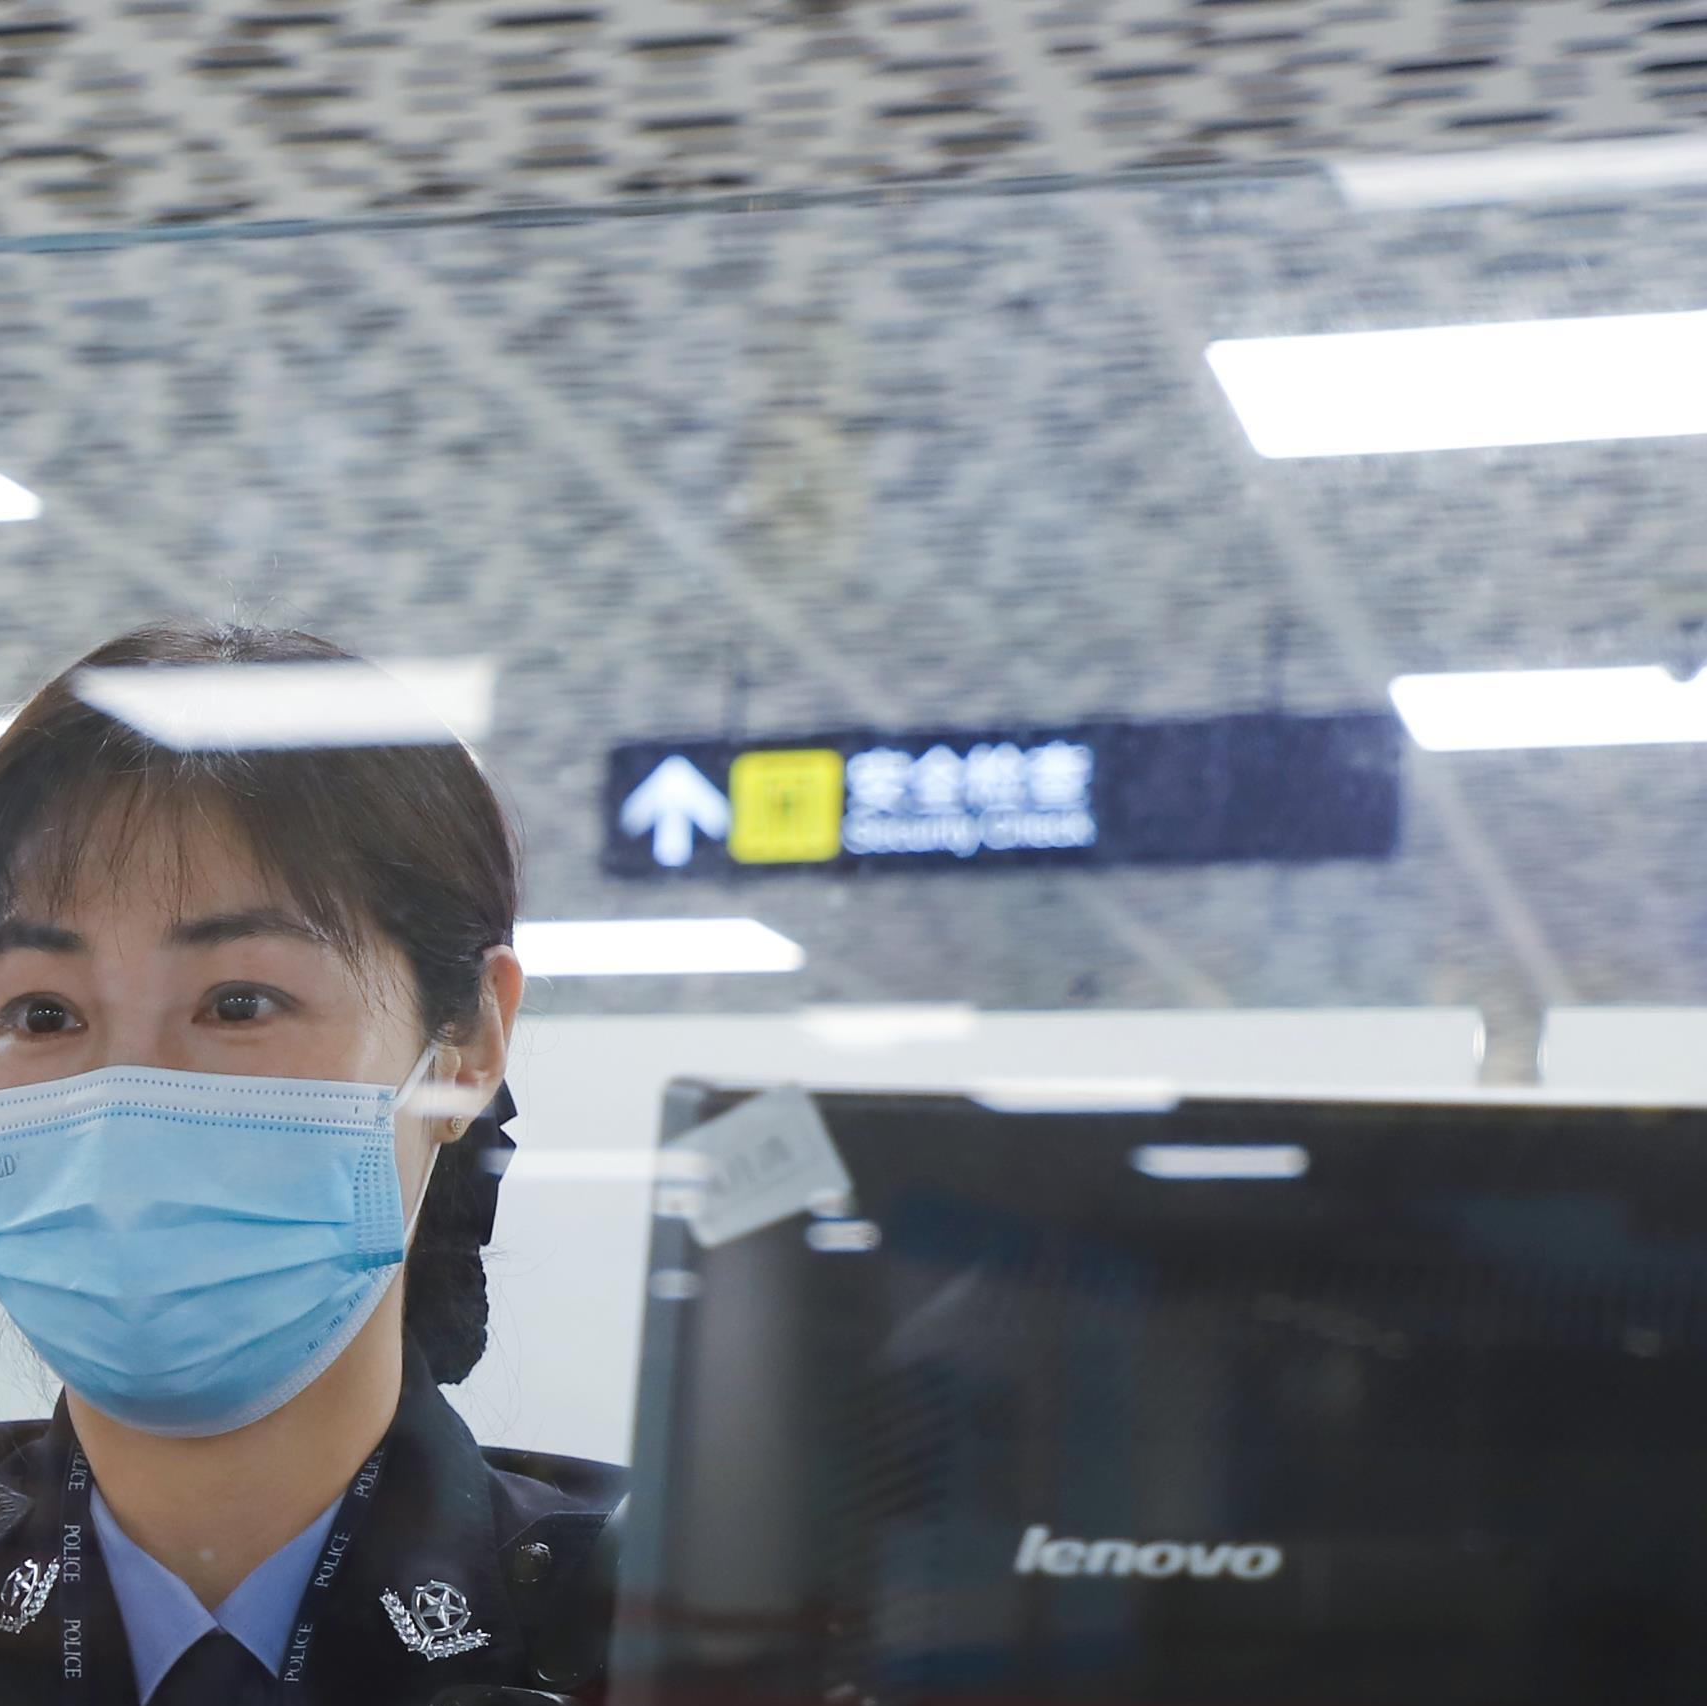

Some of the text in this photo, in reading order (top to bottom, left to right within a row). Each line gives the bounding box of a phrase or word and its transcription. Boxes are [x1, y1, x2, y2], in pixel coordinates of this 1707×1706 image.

[64, 1524, 81, 1583] POLICE
[315, 1532, 351, 1587] POLICE
[1014, 1524, 1283, 1577] lenovo
[64, 1618, 82, 1679] POLICE
[284, 1623, 314, 1682] POLICE
